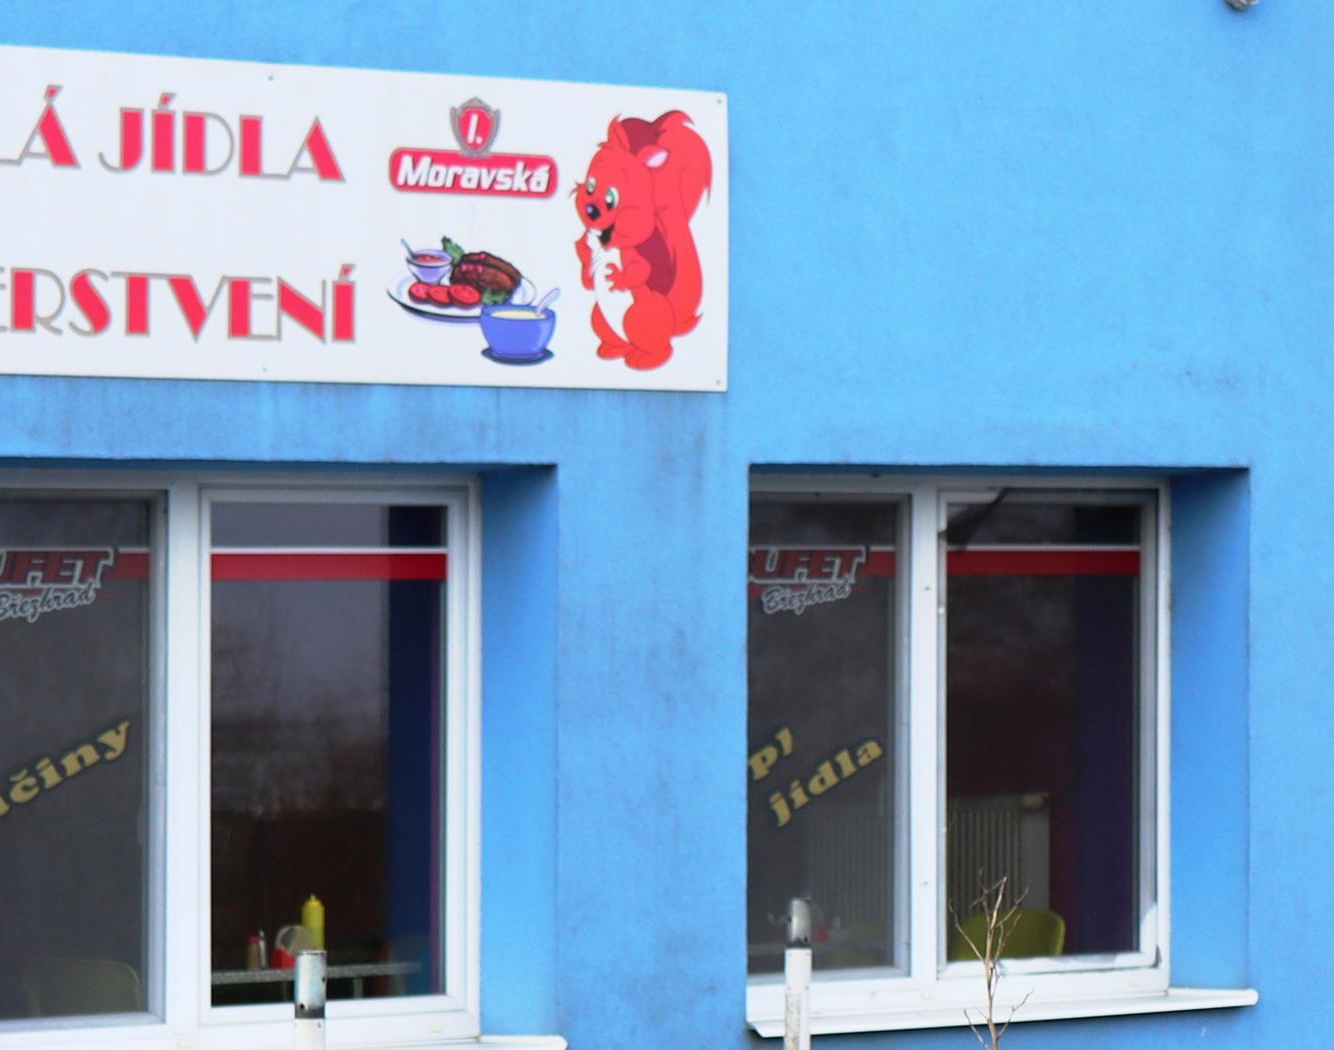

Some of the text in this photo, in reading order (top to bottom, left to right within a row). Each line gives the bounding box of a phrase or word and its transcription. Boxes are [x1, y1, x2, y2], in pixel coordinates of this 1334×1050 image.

[98, 92, 347, 183] JÍDLA
[397, 154, 551, 194] Moravská
[749, 546, 866, 584] UFET
